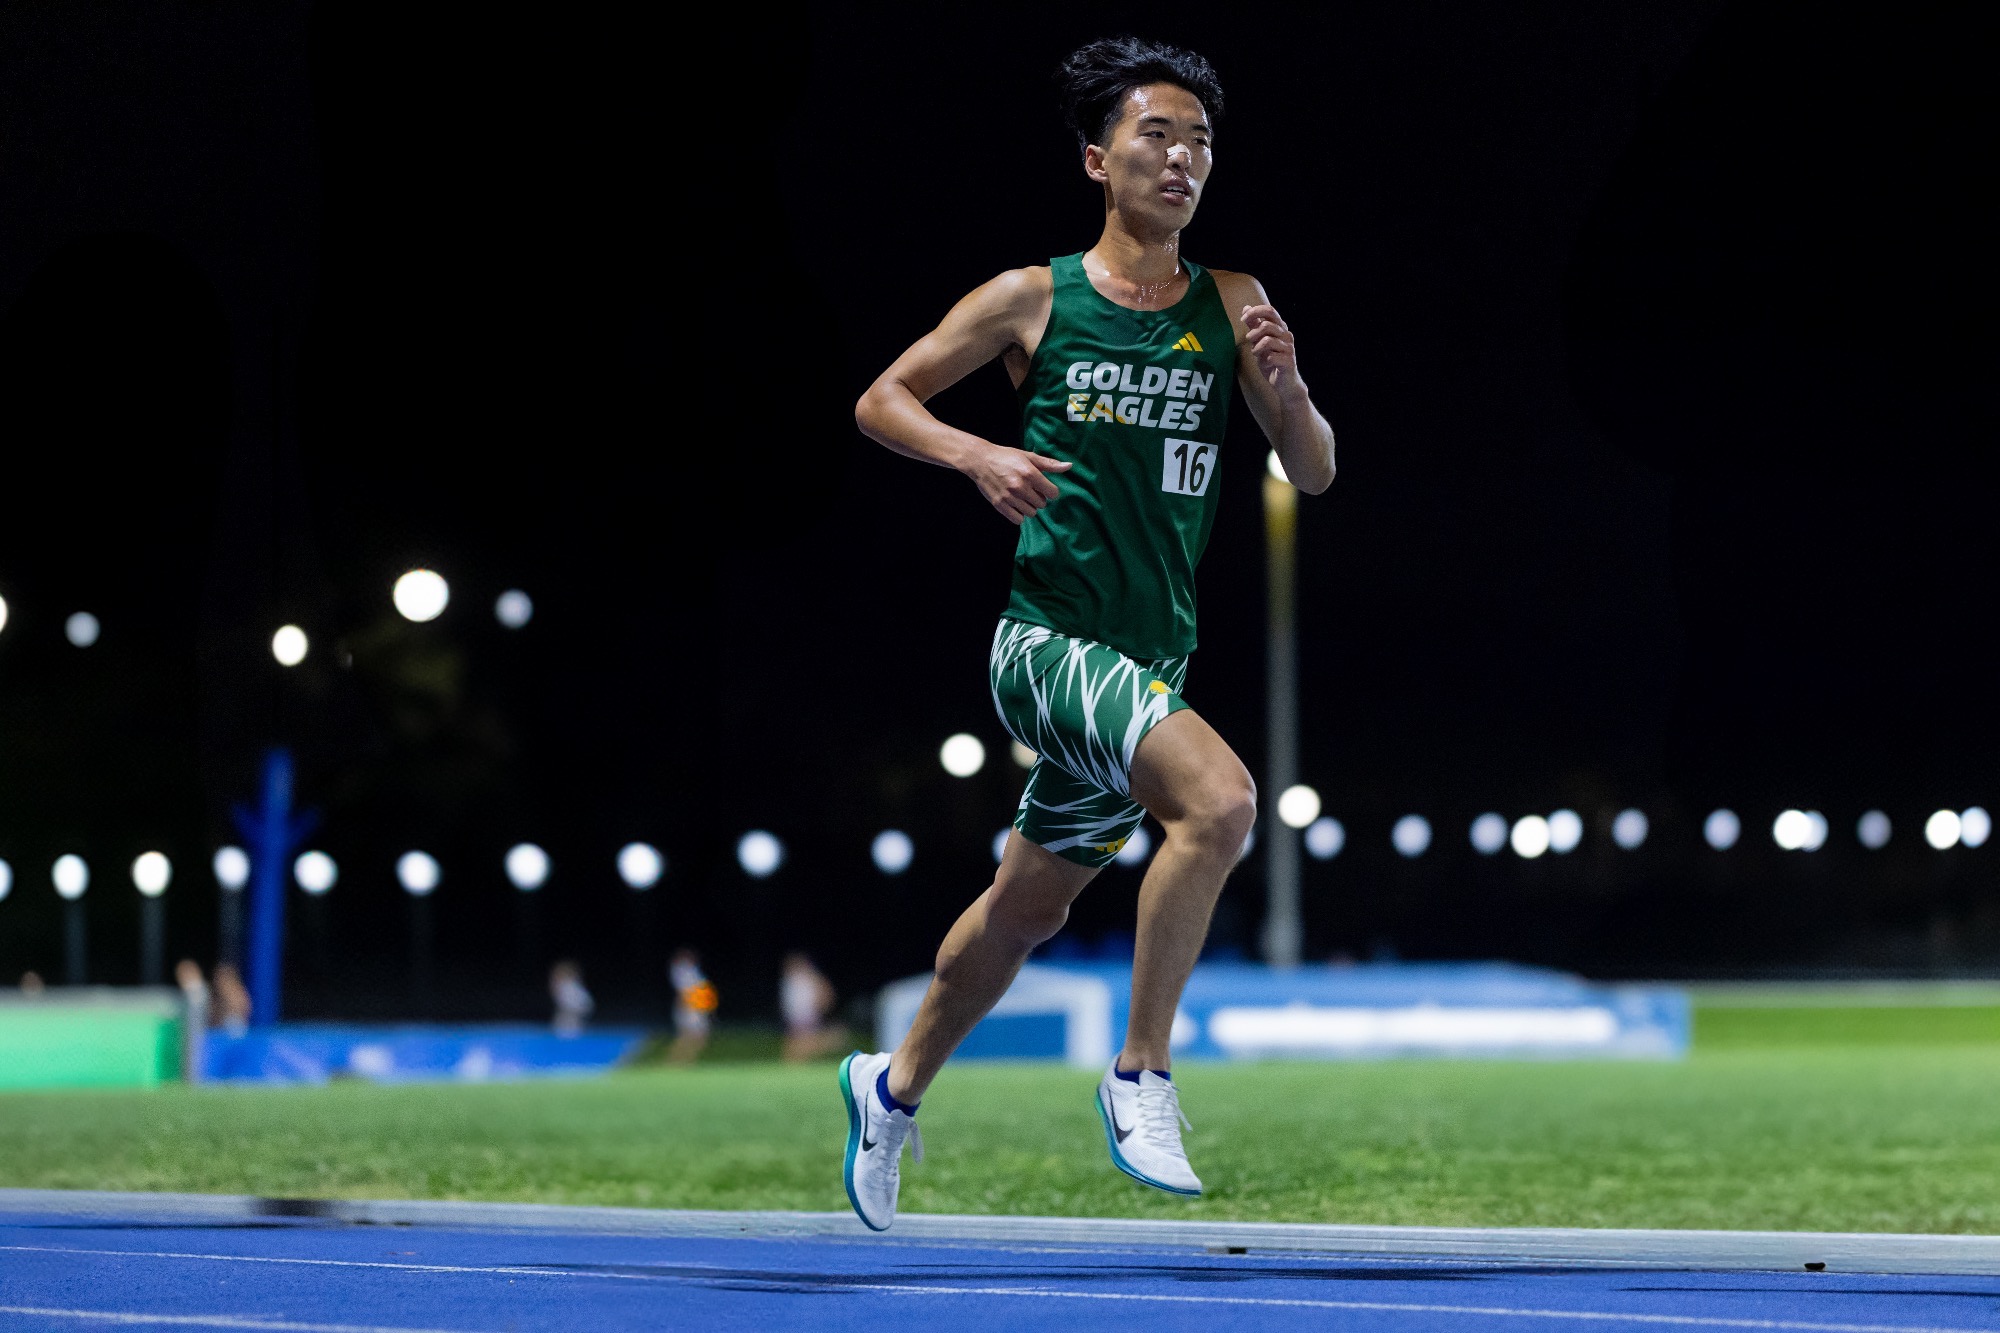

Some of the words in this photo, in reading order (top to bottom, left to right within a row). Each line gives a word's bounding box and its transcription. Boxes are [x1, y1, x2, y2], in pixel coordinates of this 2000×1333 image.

[1066, 361, 1214, 401] GOLDEN
[1066, 393, 1206, 431] EAGLES
[1174, 443, 1209, 493] 16
